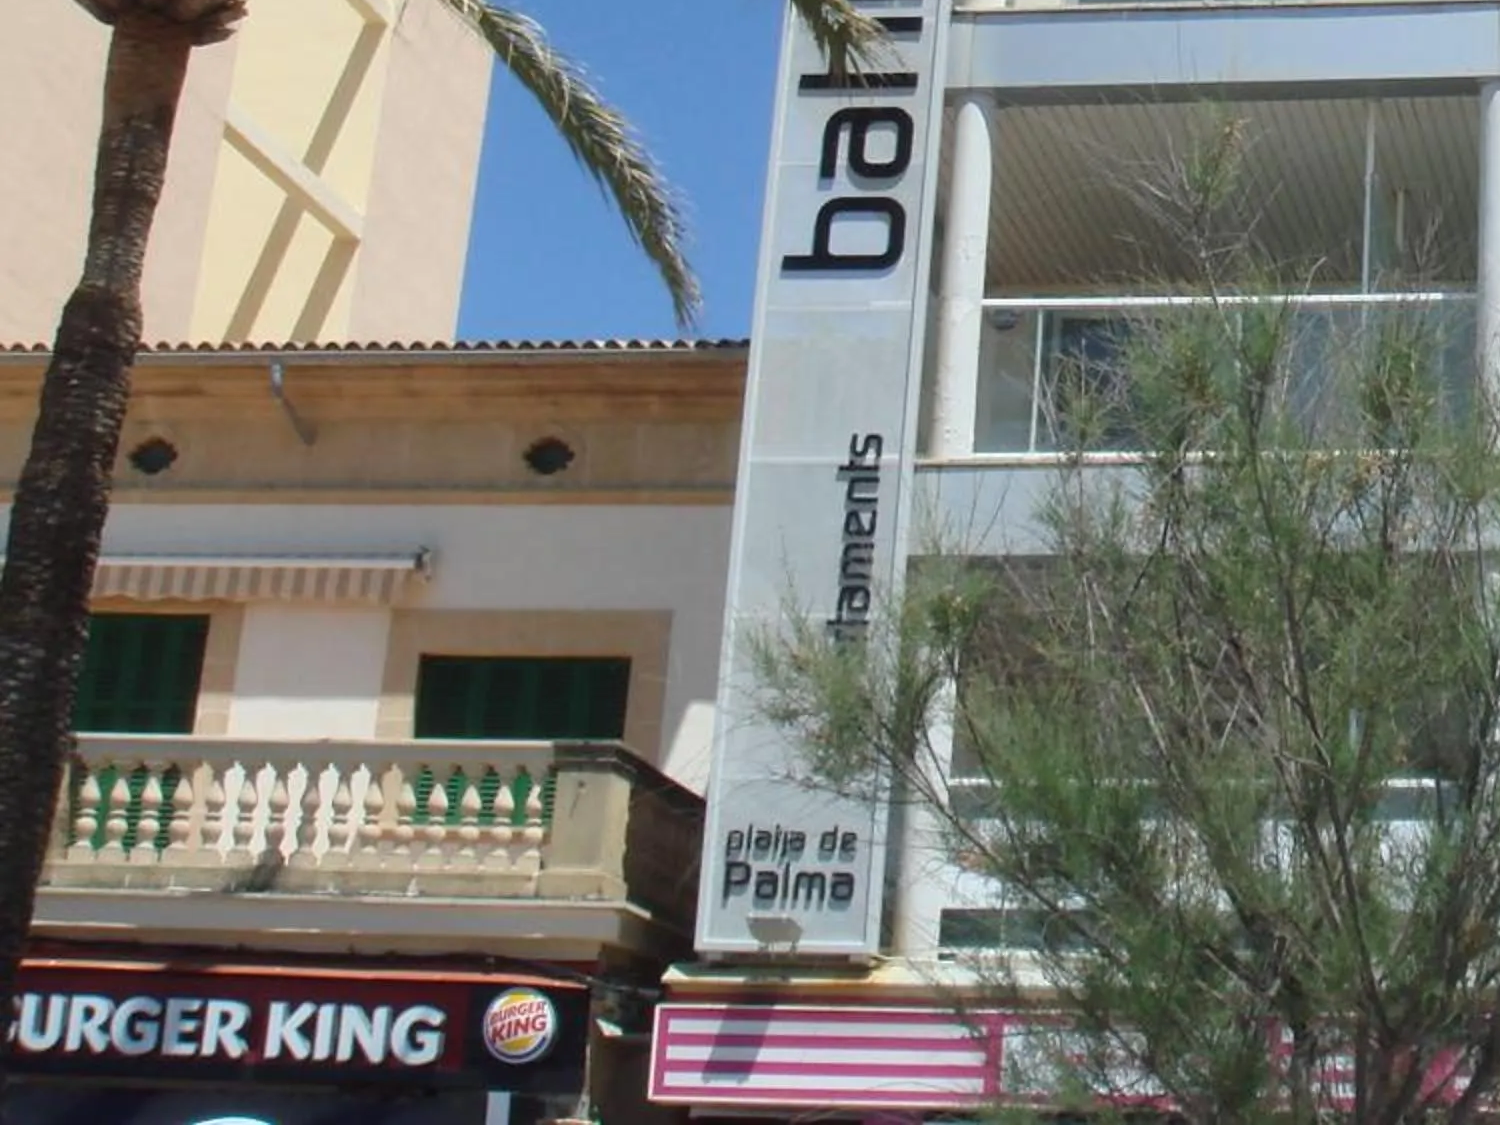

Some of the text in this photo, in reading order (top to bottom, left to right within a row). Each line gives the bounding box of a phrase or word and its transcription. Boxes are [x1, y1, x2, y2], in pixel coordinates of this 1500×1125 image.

[820, 825, 858, 852] de
[722, 861, 855, 902] Palma
[490, 1001, 547, 1026] BURGER
[264, 1001, 447, 1065] KING
[491, 1015, 547, 1043] KING
